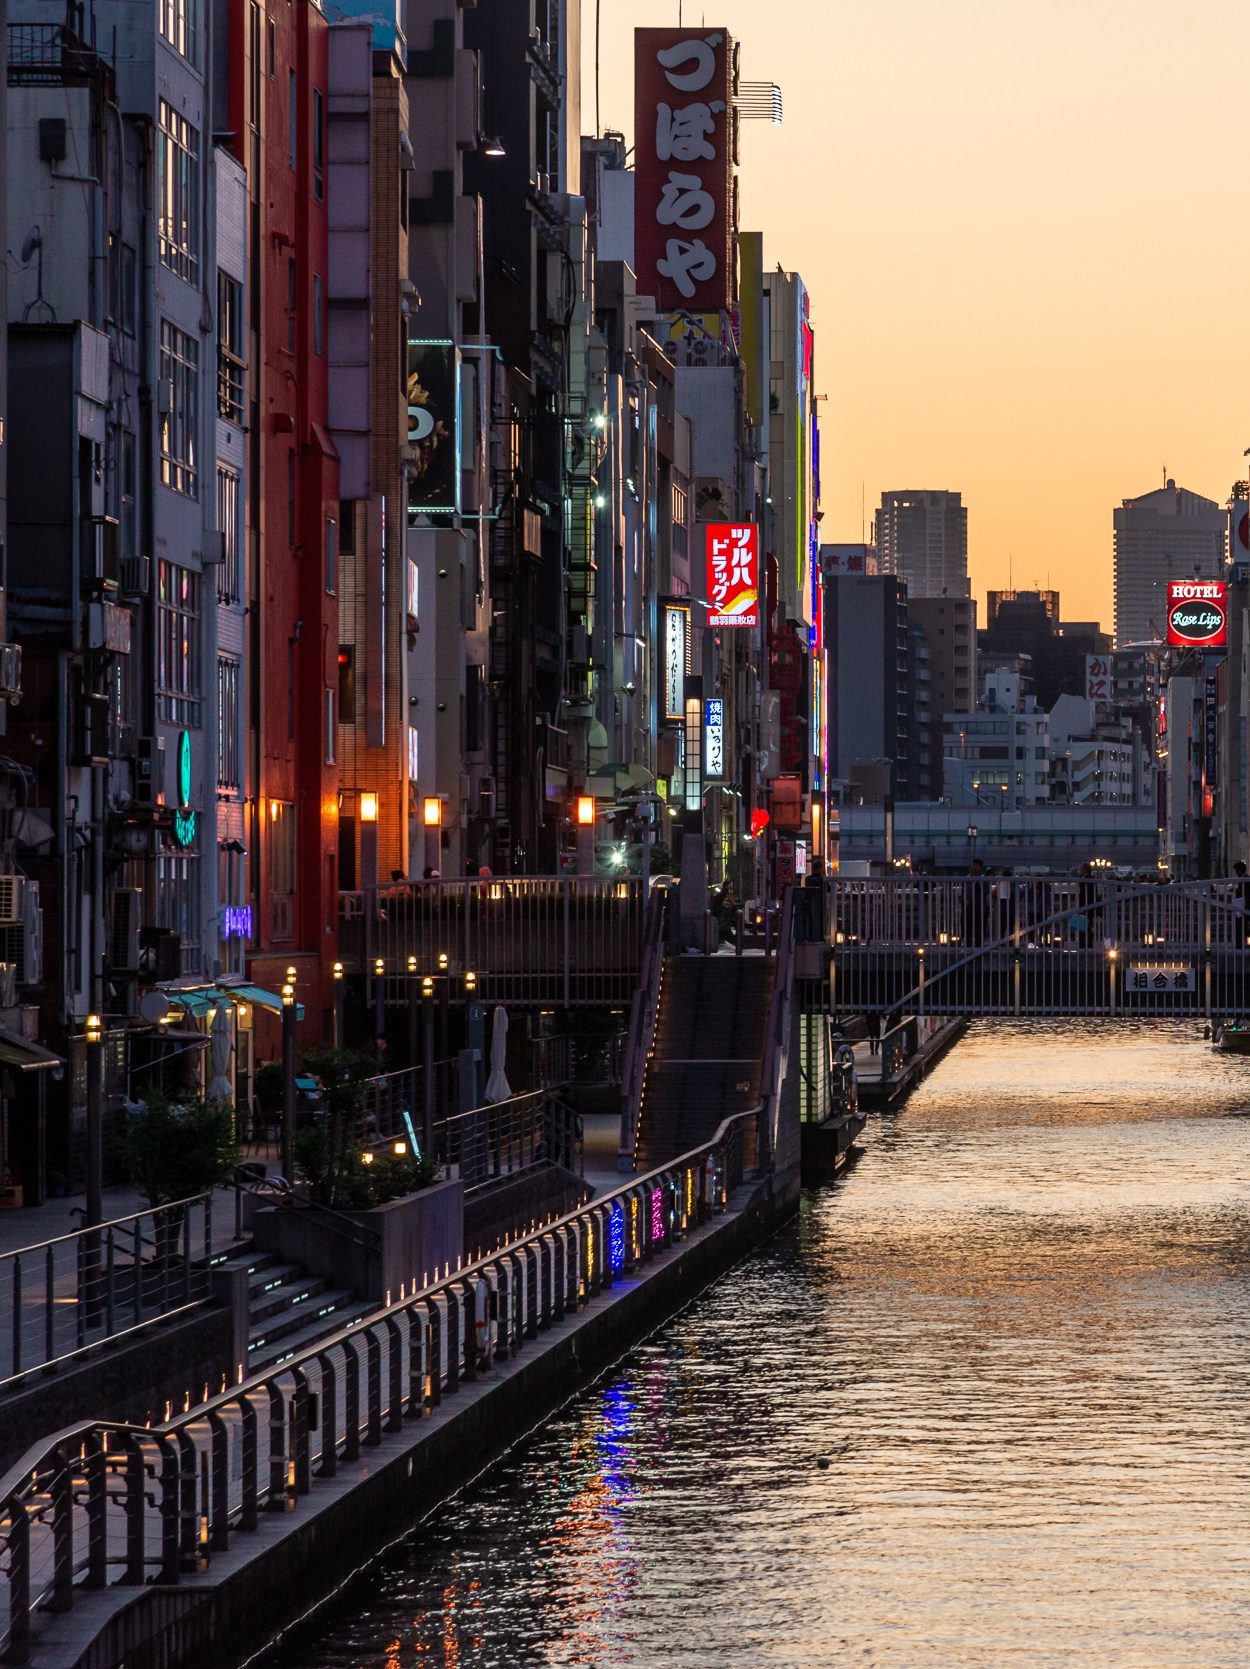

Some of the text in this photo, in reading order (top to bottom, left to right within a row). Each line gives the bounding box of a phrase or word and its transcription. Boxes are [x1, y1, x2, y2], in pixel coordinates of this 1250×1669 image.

[656, 32, 726, 298] づぼらや
[712, 539, 730, 601] ドラッグ
[731, 529, 752, 585] ツルハ
[1172, 585, 1222, 598] HOTEL
[1172, 612, 1222, 629] Rose Lips
[1088, 657, 1108, 699] かに
[709, 702, 721, 773] 焼肉 いろりや
[1133, 971, 1189, 989] 相合橋
